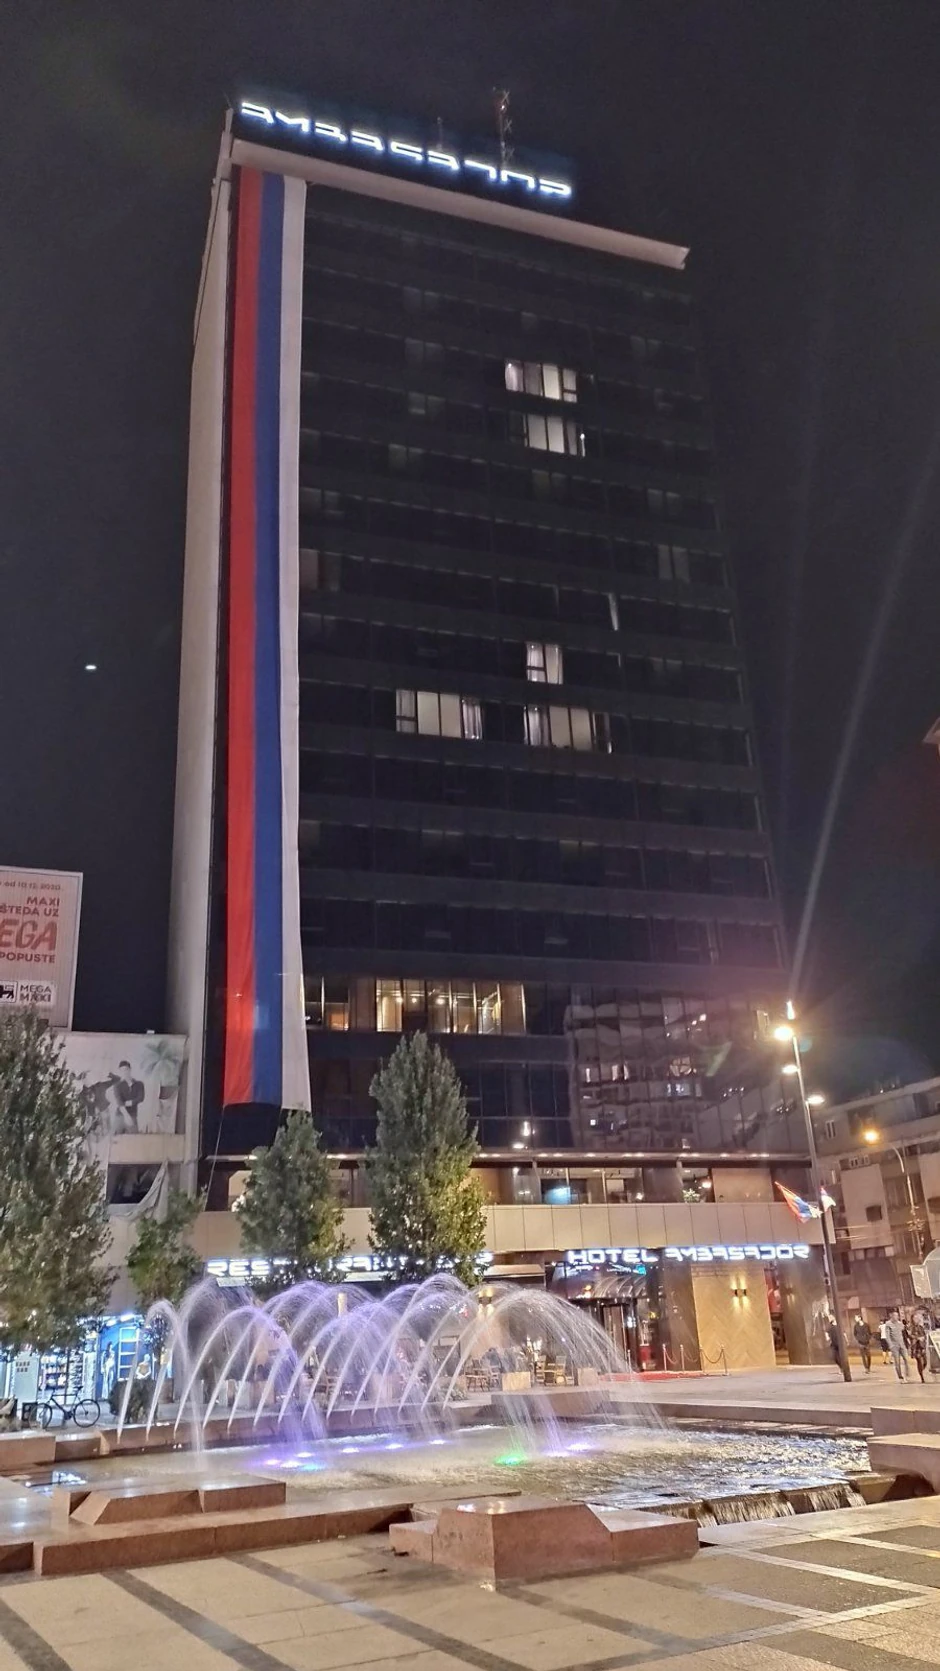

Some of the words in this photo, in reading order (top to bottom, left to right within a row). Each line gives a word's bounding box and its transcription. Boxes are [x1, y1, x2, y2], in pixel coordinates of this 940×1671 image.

[26, 896, 60, 907] MAXI
[43, 907, 59, 917] UZ
[0, 951, 55, 963] POPUSTE
[20, 984, 52, 993] MEGA
[20, 992, 52, 1002] MAXI
[567, 1248, 659, 1264] HOTEL
